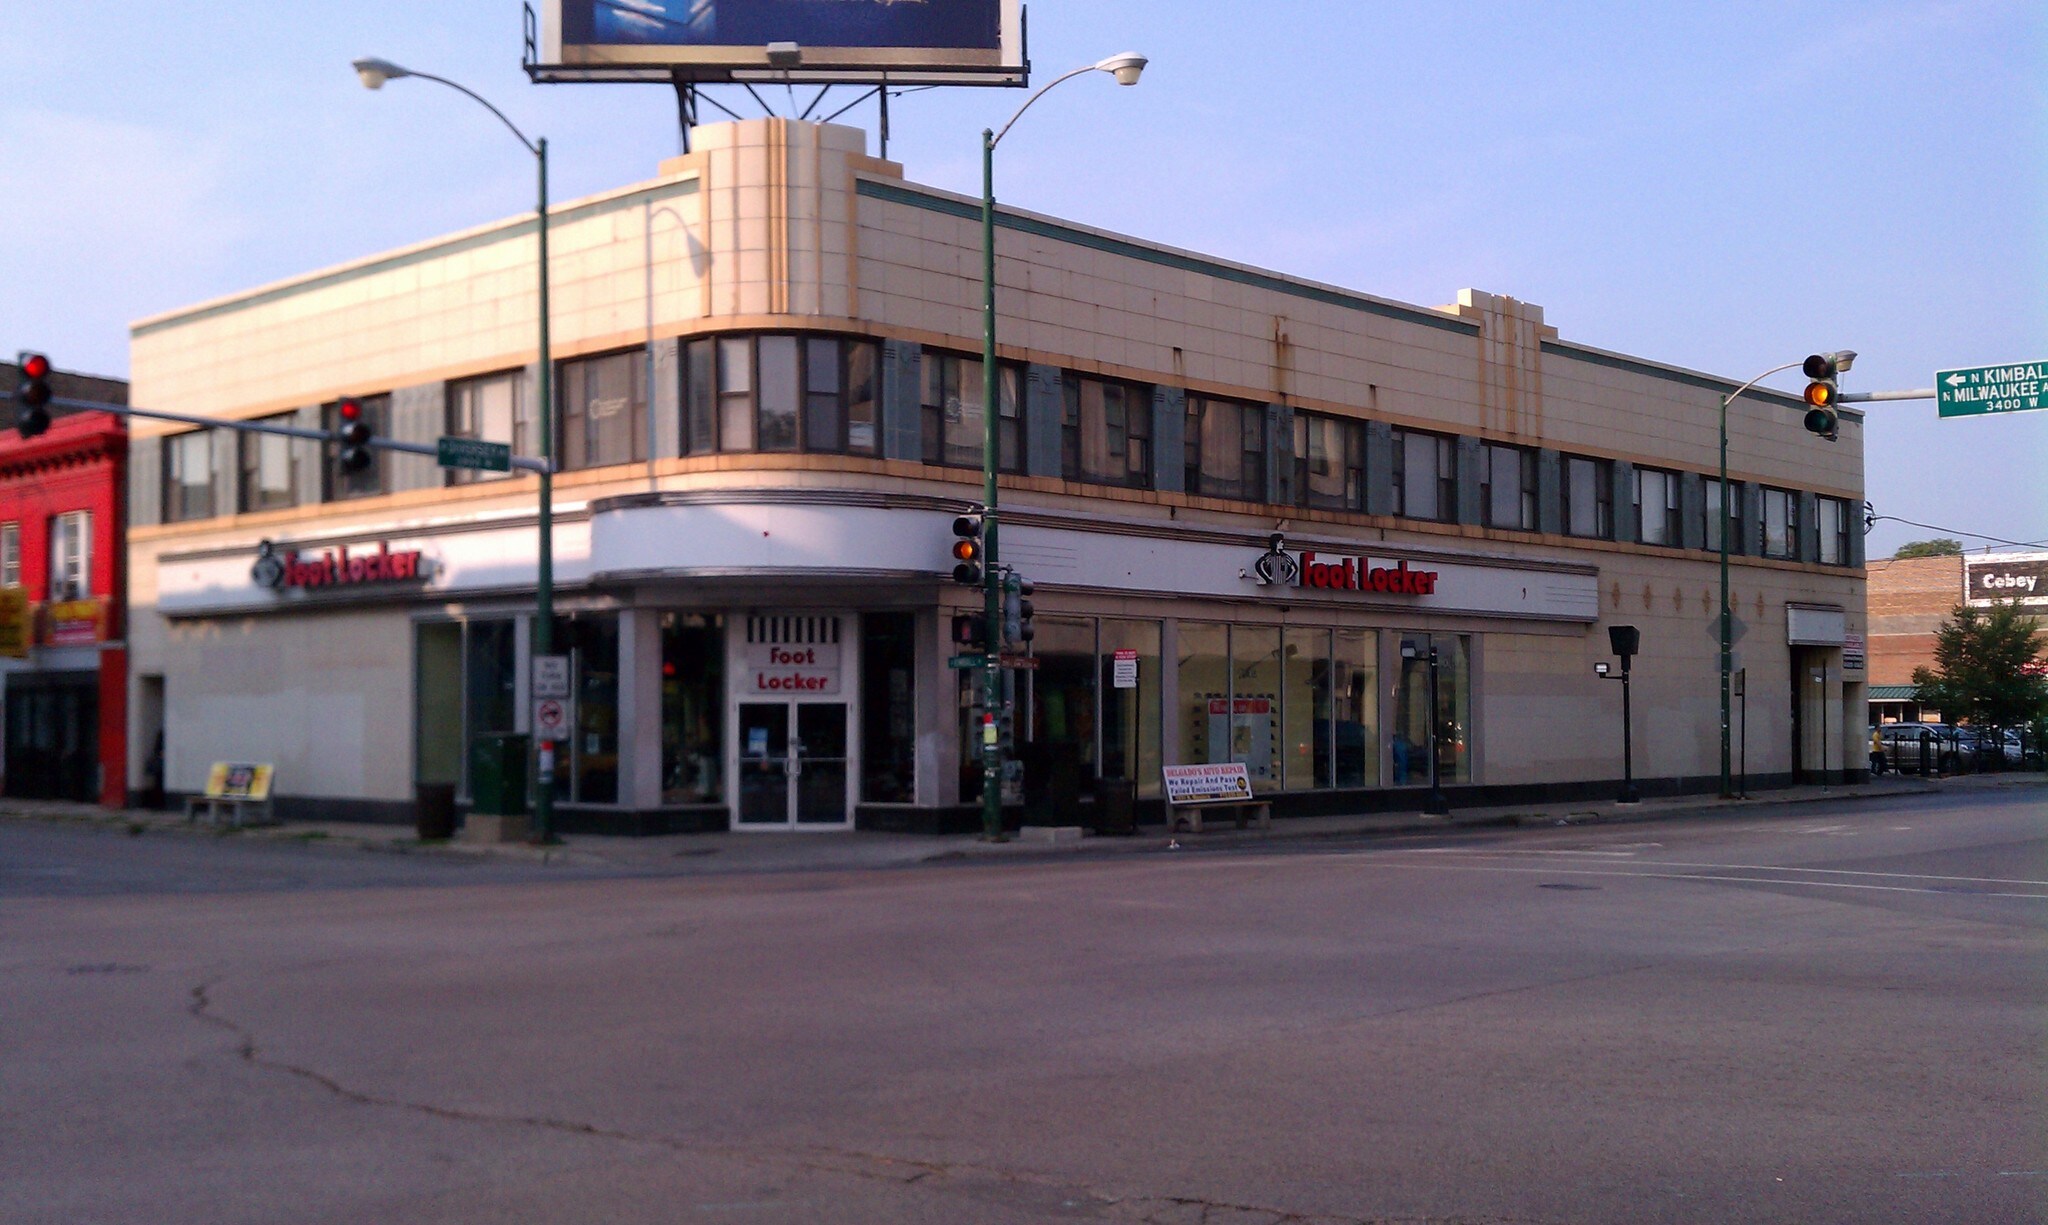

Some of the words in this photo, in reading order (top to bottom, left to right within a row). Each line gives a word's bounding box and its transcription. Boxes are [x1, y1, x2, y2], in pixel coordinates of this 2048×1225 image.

[1971, 373, 1980, 383] N
[1943, 391, 1950, 401] N
[1955, 381, 2039, 402] MILWAUKEE
[1986, 399, 2021, 411] 3400
[2029, 397, 2038, 408] W
[1300, 551, 1356, 589] Foot
[1358, 556, 1438, 595] Locker
[1983, 573, 2038, 592] Cebey
[771, 647, 815, 664] Foot
[758, 672, 828, 690] Locker
[1203, 767, 1220, 776] AUTO
[1221, 765, 1244, 775] REPAIR
[1205, 776, 1218, 784] And
